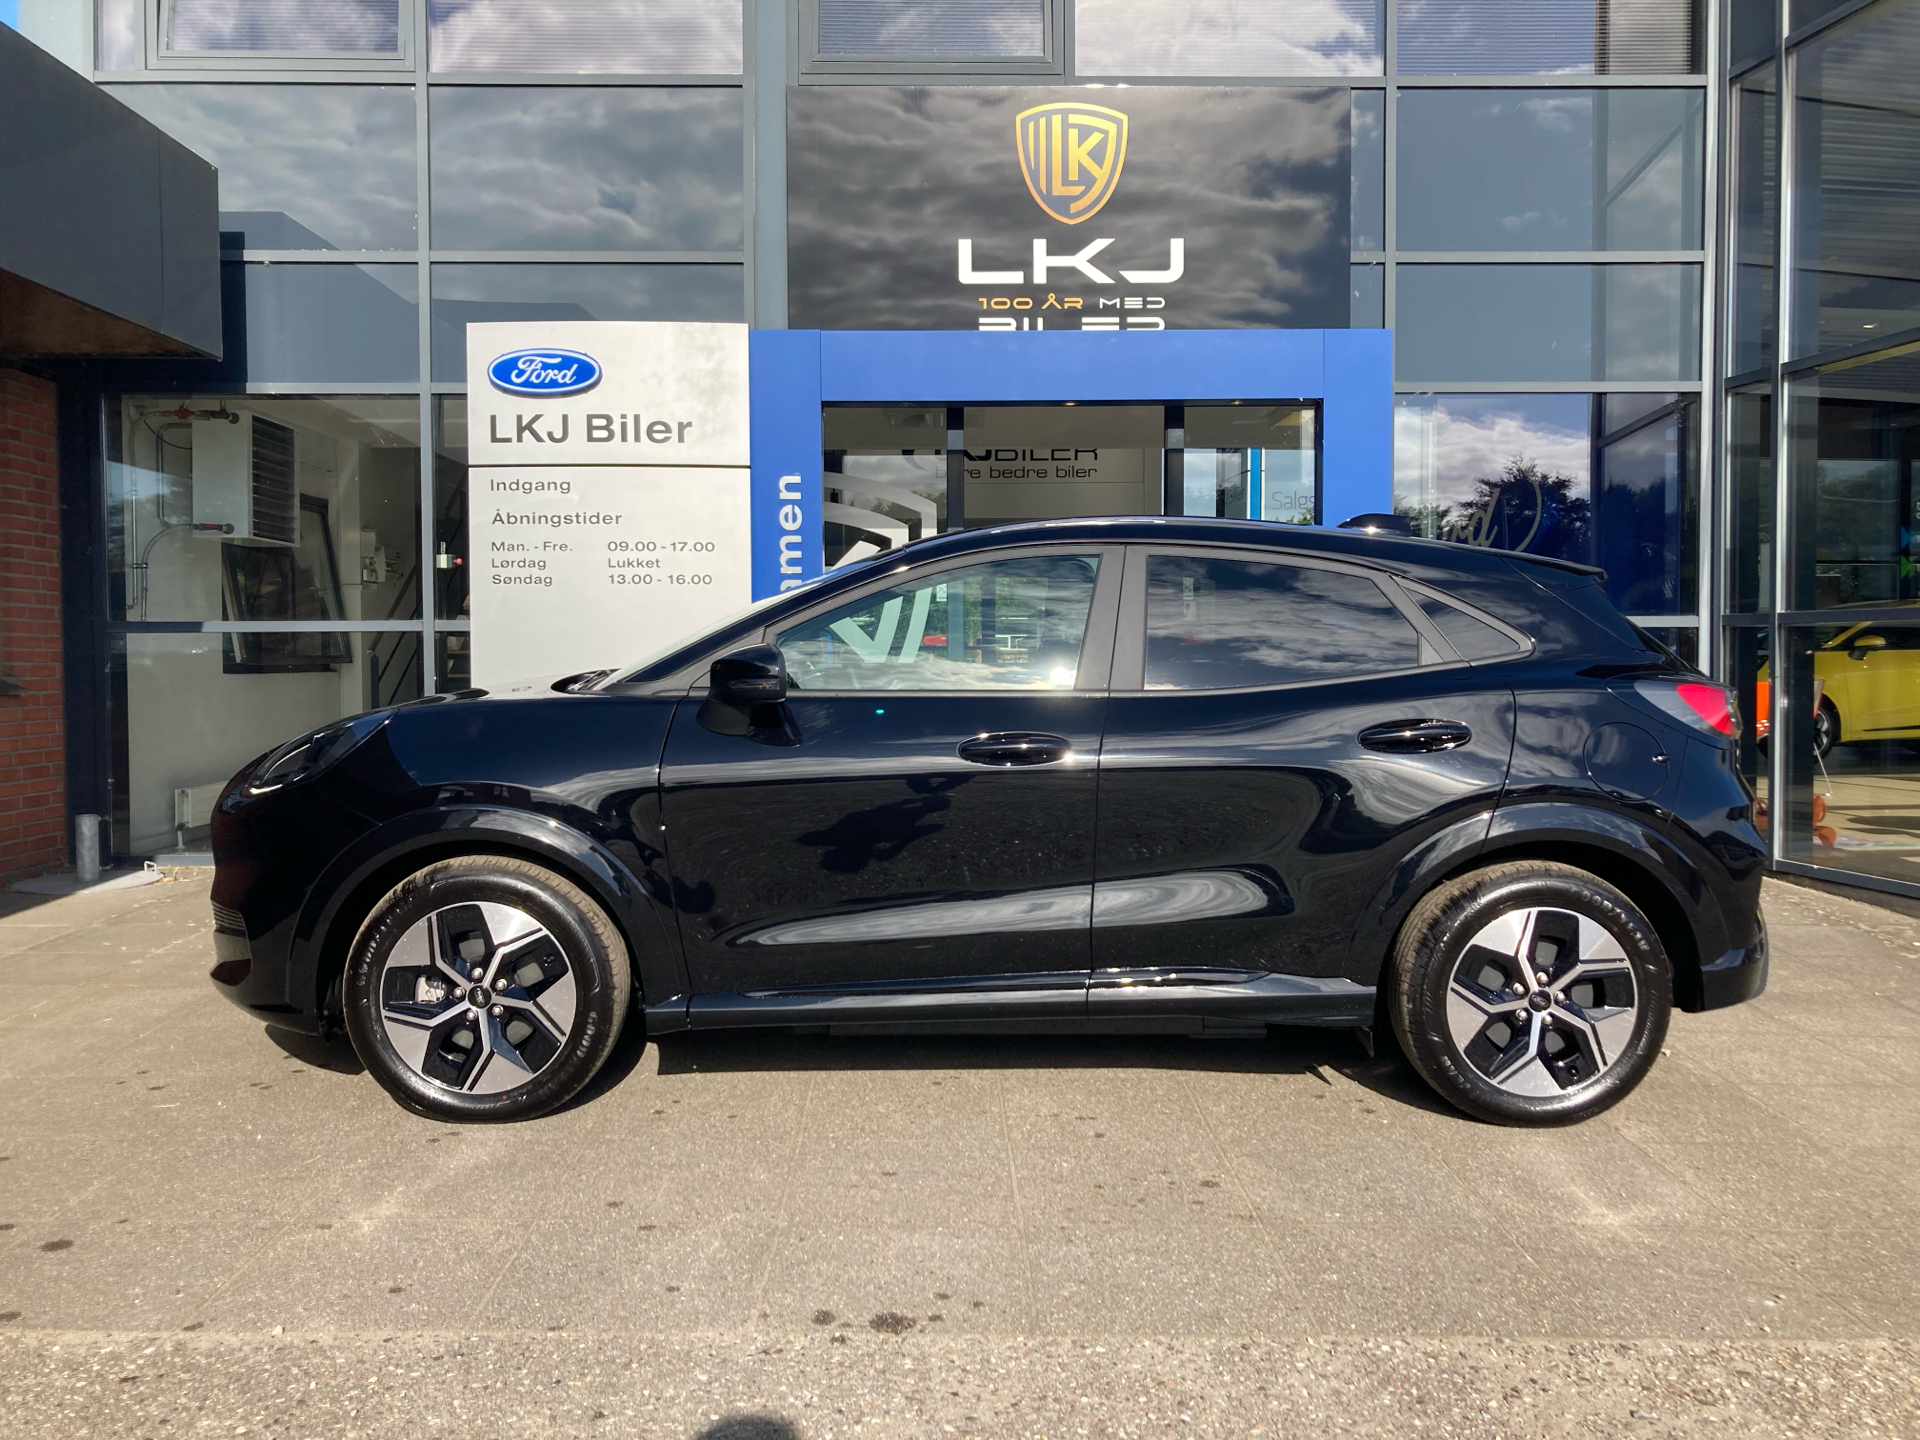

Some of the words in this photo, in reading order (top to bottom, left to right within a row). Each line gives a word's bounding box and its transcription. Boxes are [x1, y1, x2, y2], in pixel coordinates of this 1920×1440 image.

[957, 237, 1185, 285] LKJ
[978, 297, 1034, 309] 100
[1041, 292, 1084, 309] ÅR
[1099, 297, 1166, 309] MED
[510, 356, 577, 385] Ford
[489, 413, 570, 444] LKJ
[586, 413, 693, 444] Biler
[989, 466, 1048, 479] bedre
[1055, 465, 1098, 478] biler
[490, 478, 571, 494] Indgang
[491, 508, 622, 528] Åbningstider
[491, 541, 530, 552] Man.
[543, 541, 572, 552] Fre.
[607, 541, 657, 552] 09.00
[670, 541, 715, 552] 17.00
[491, 557, 547, 571] Lørdag
[608, 557, 661, 568] Lukket
[491, 573, 553, 586] Søndag
[608, 573, 653, 585] 13.00
[667, 573, 713, 585] 16.00
